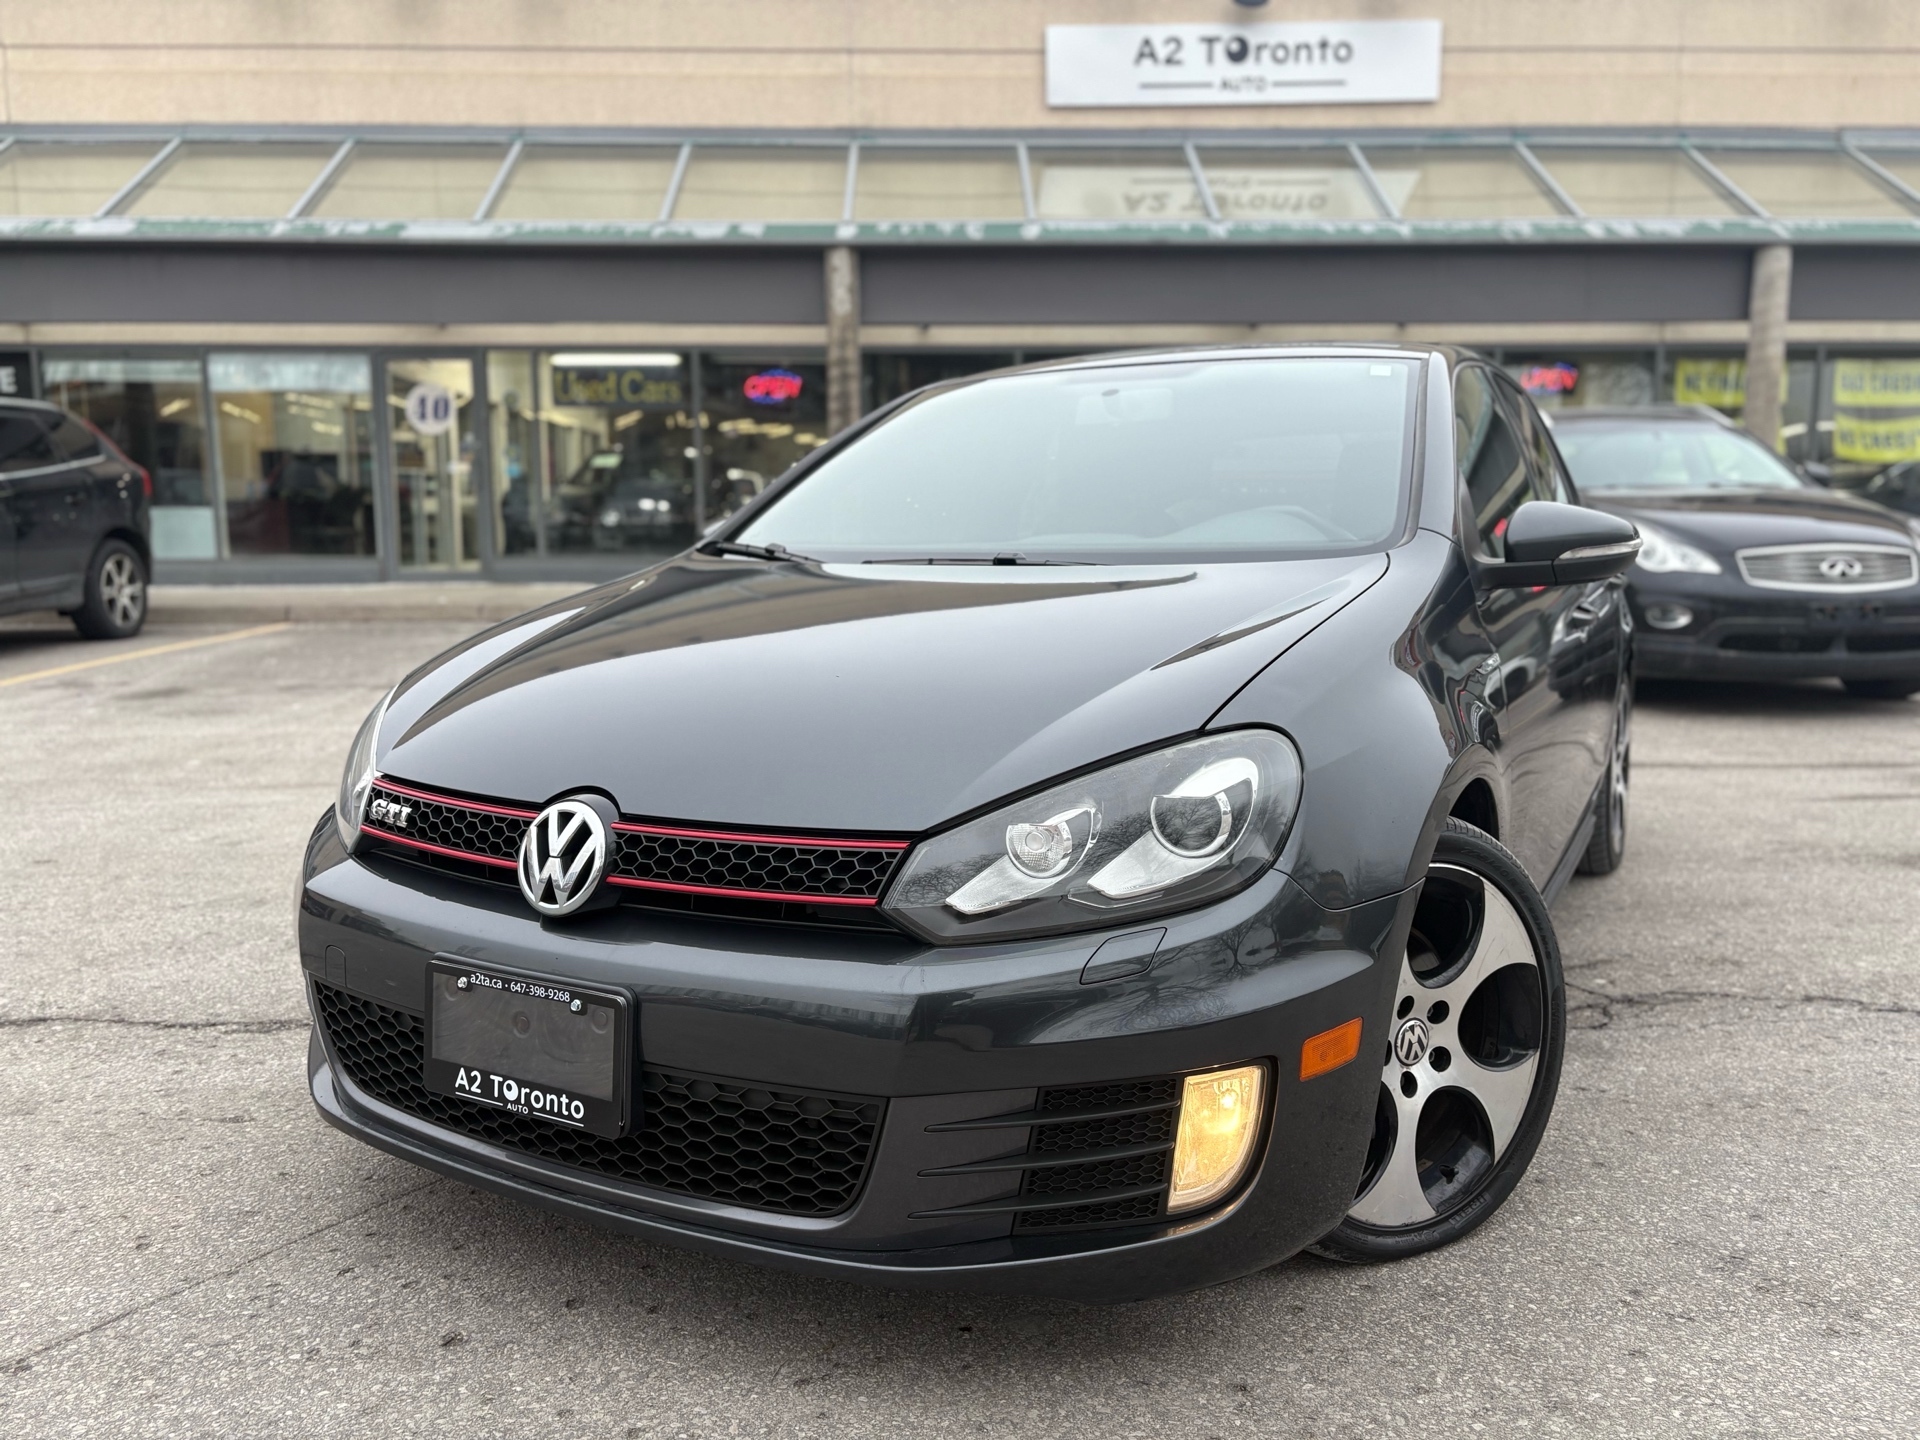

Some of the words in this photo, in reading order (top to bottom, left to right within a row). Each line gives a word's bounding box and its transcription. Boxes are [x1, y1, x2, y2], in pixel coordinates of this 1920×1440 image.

[1133, 36, 1184, 66] A2
[415, 396, 450, 422] 10
[370, 798, 412, 828] GTI
[470, 973, 502, 989] a2ta.ca
[510, 981, 570, 1002] 647-398-9268
[455, 1067, 482, 1093] A2
[507, 1102, 529, 1114] AUTO
